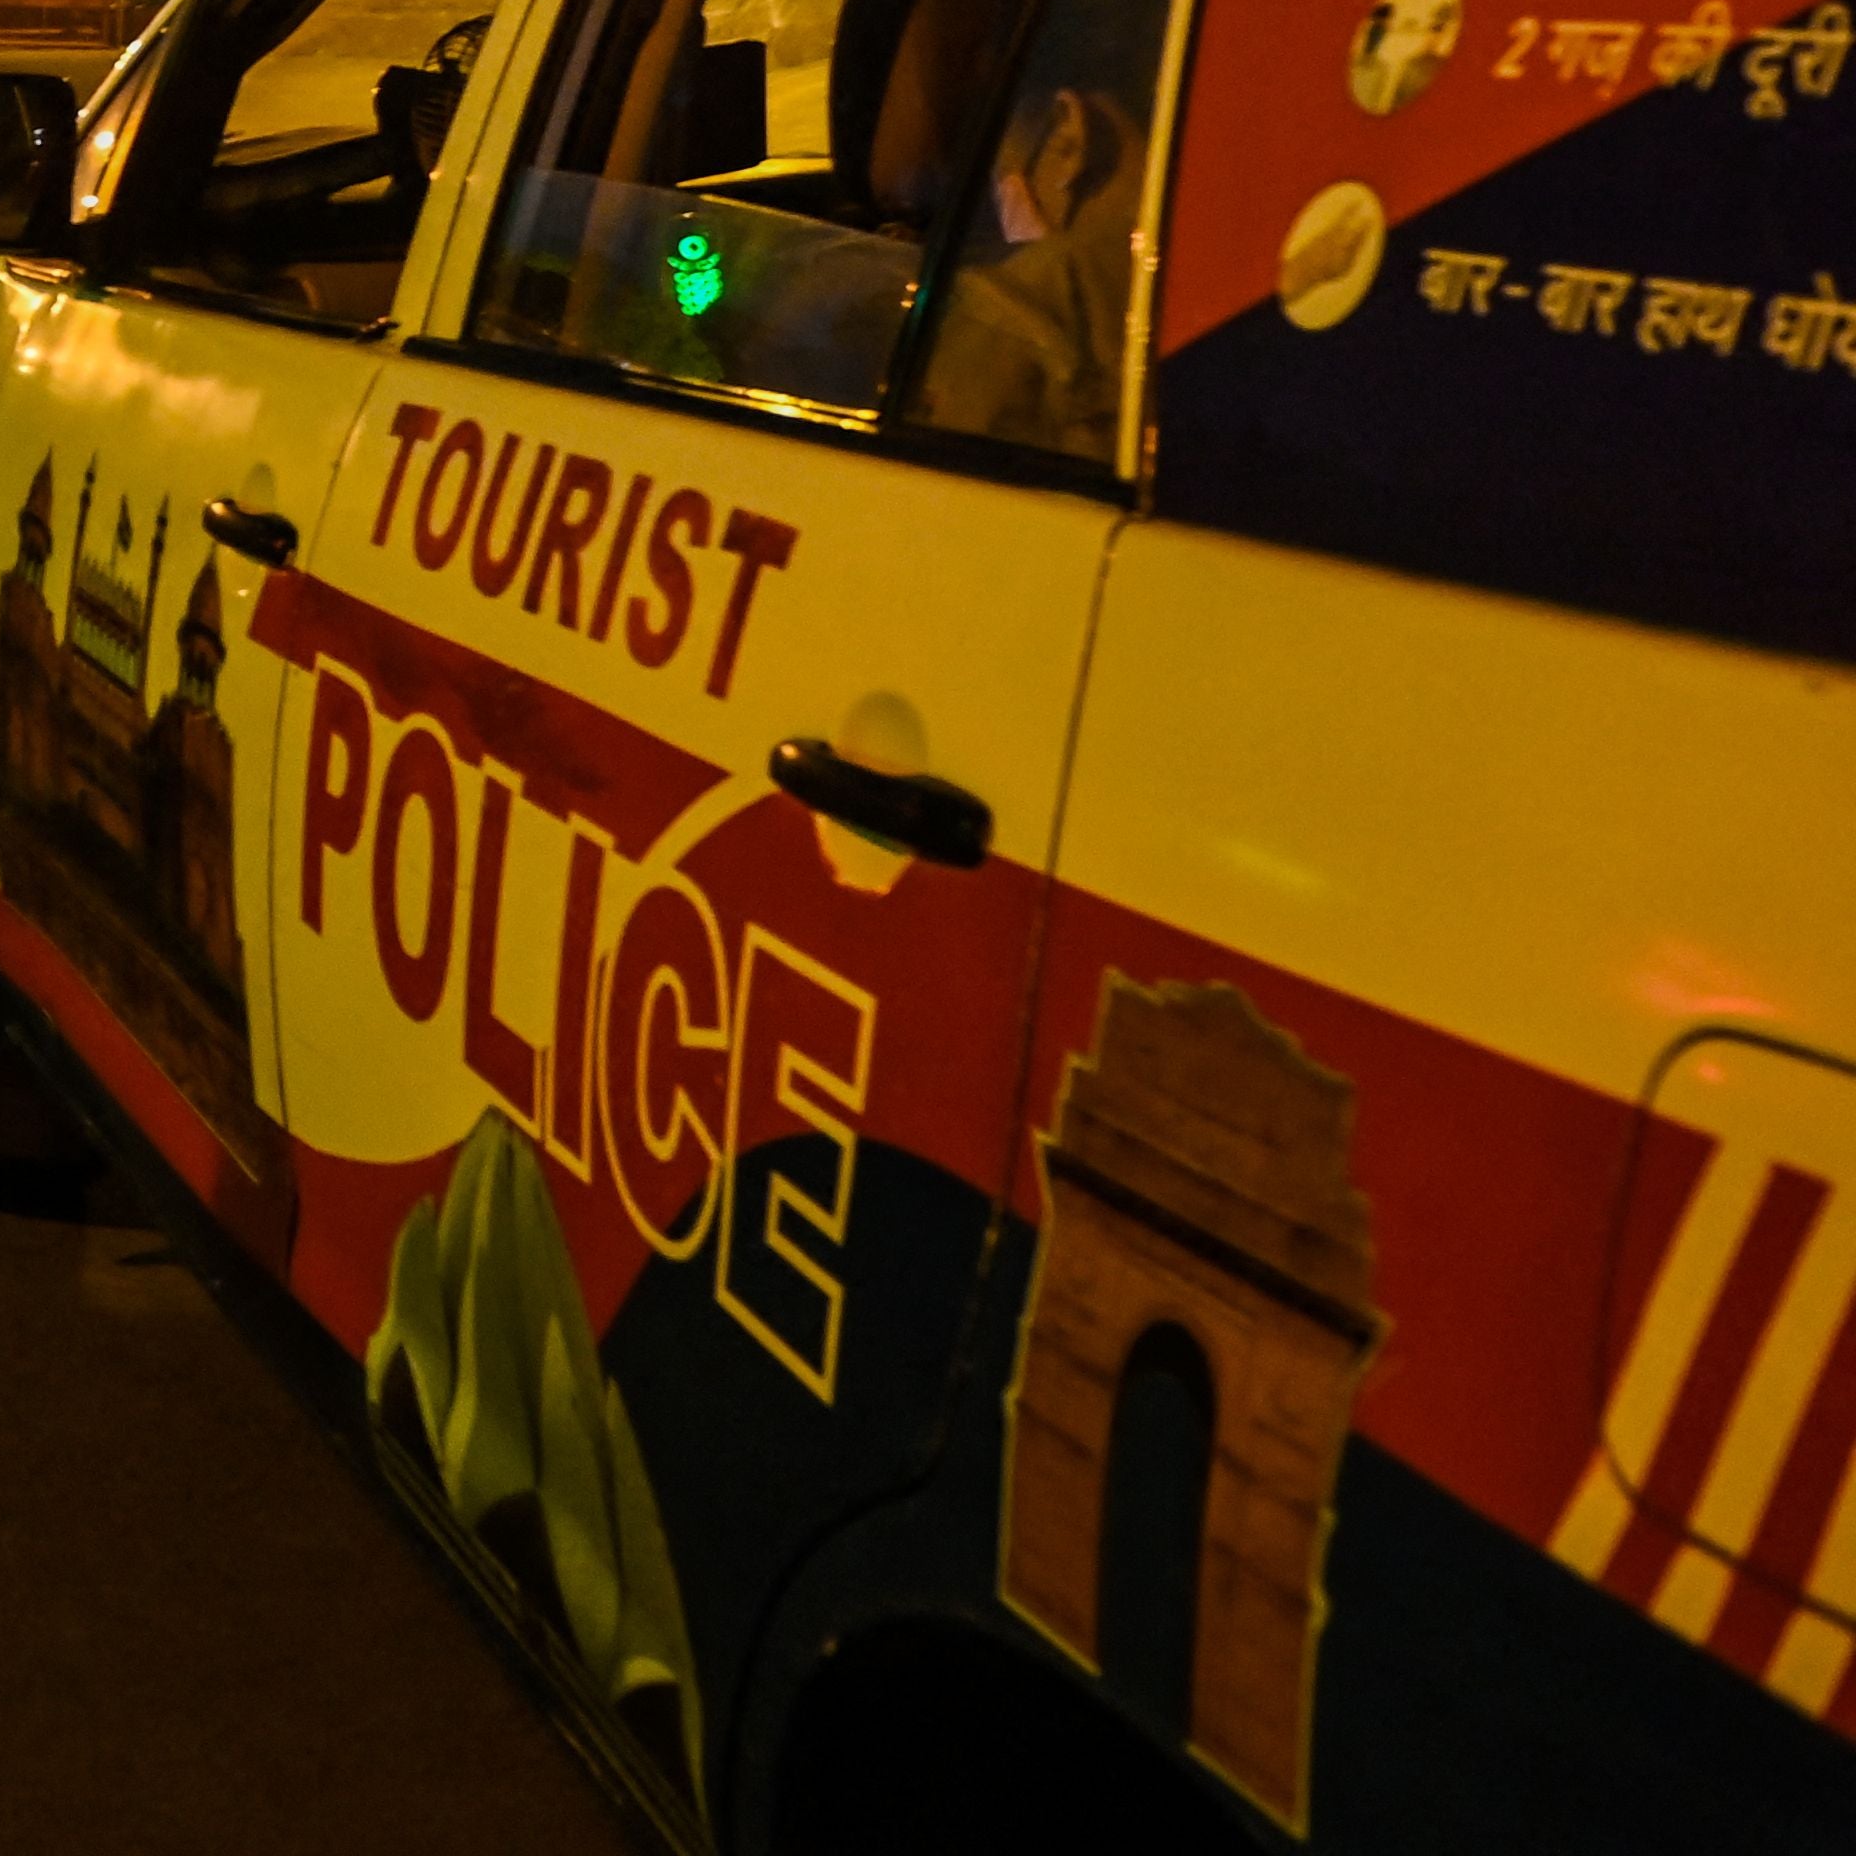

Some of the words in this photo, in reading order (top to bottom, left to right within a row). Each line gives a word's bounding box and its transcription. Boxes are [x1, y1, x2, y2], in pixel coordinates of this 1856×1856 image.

[1492, 14, 1539, 80] 2
[1742, 0, 1855, 121] दूरी
[370, 401, 800, 700] TOURIST
[300, 652, 878, 1407] POLICE
